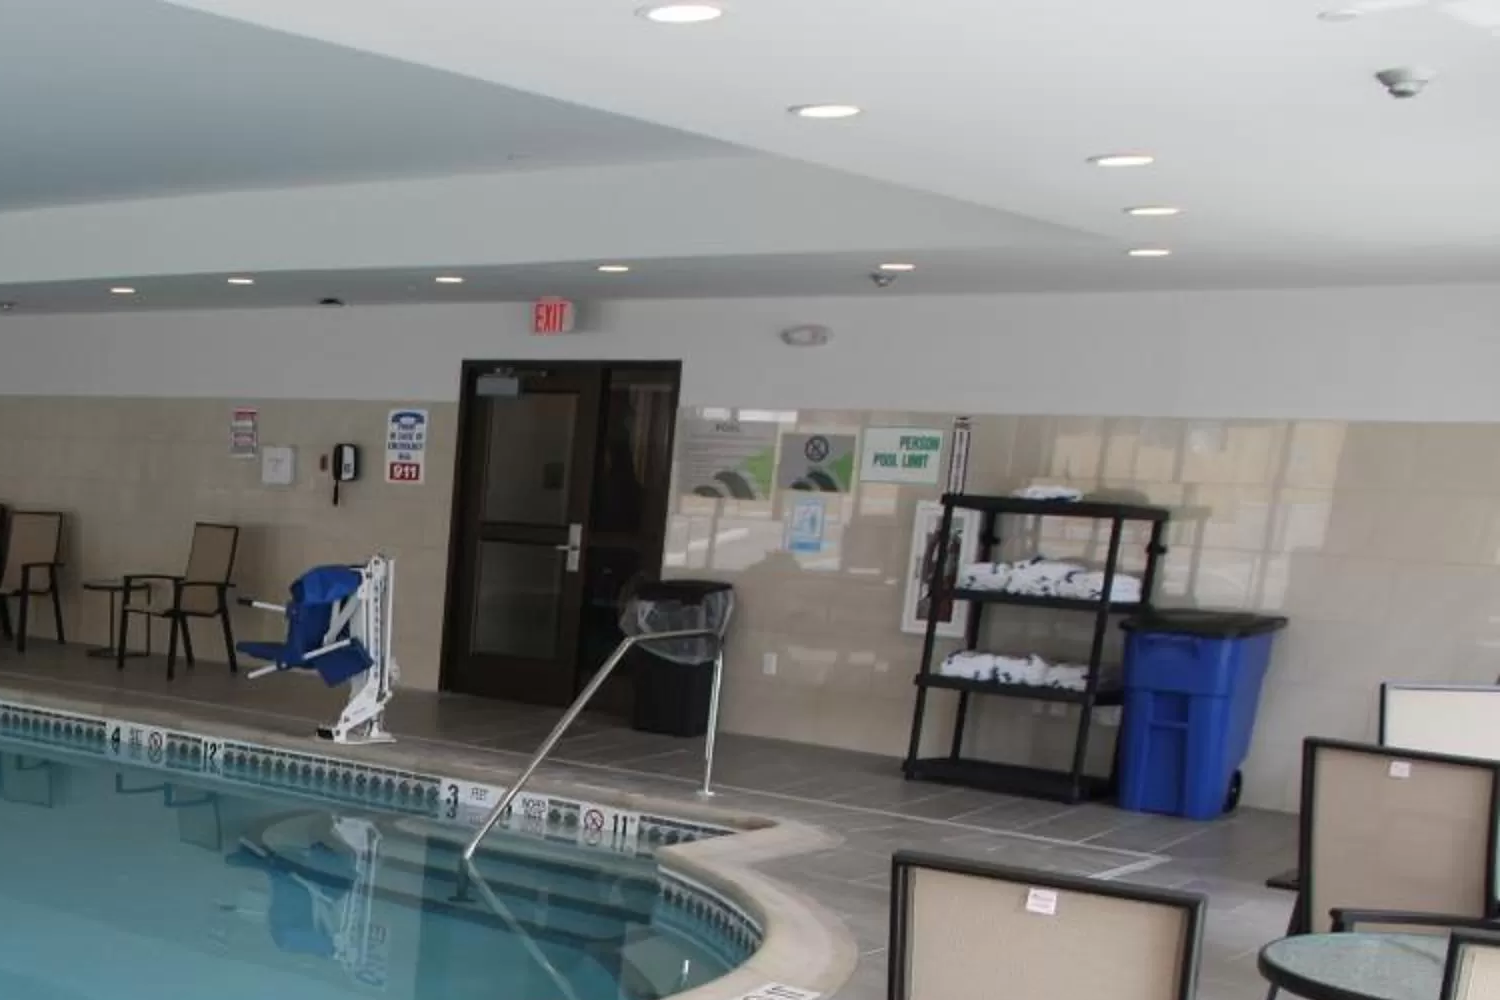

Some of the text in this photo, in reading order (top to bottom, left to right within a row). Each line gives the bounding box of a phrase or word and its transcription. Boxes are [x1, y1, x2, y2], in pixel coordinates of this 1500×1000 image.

[535, 303, 567, 332] EXIT
[900, 435, 940, 452] PERSON
[874, 452, 929, 469] POOL LIMIT
[393, 464, 418, 479] 911
